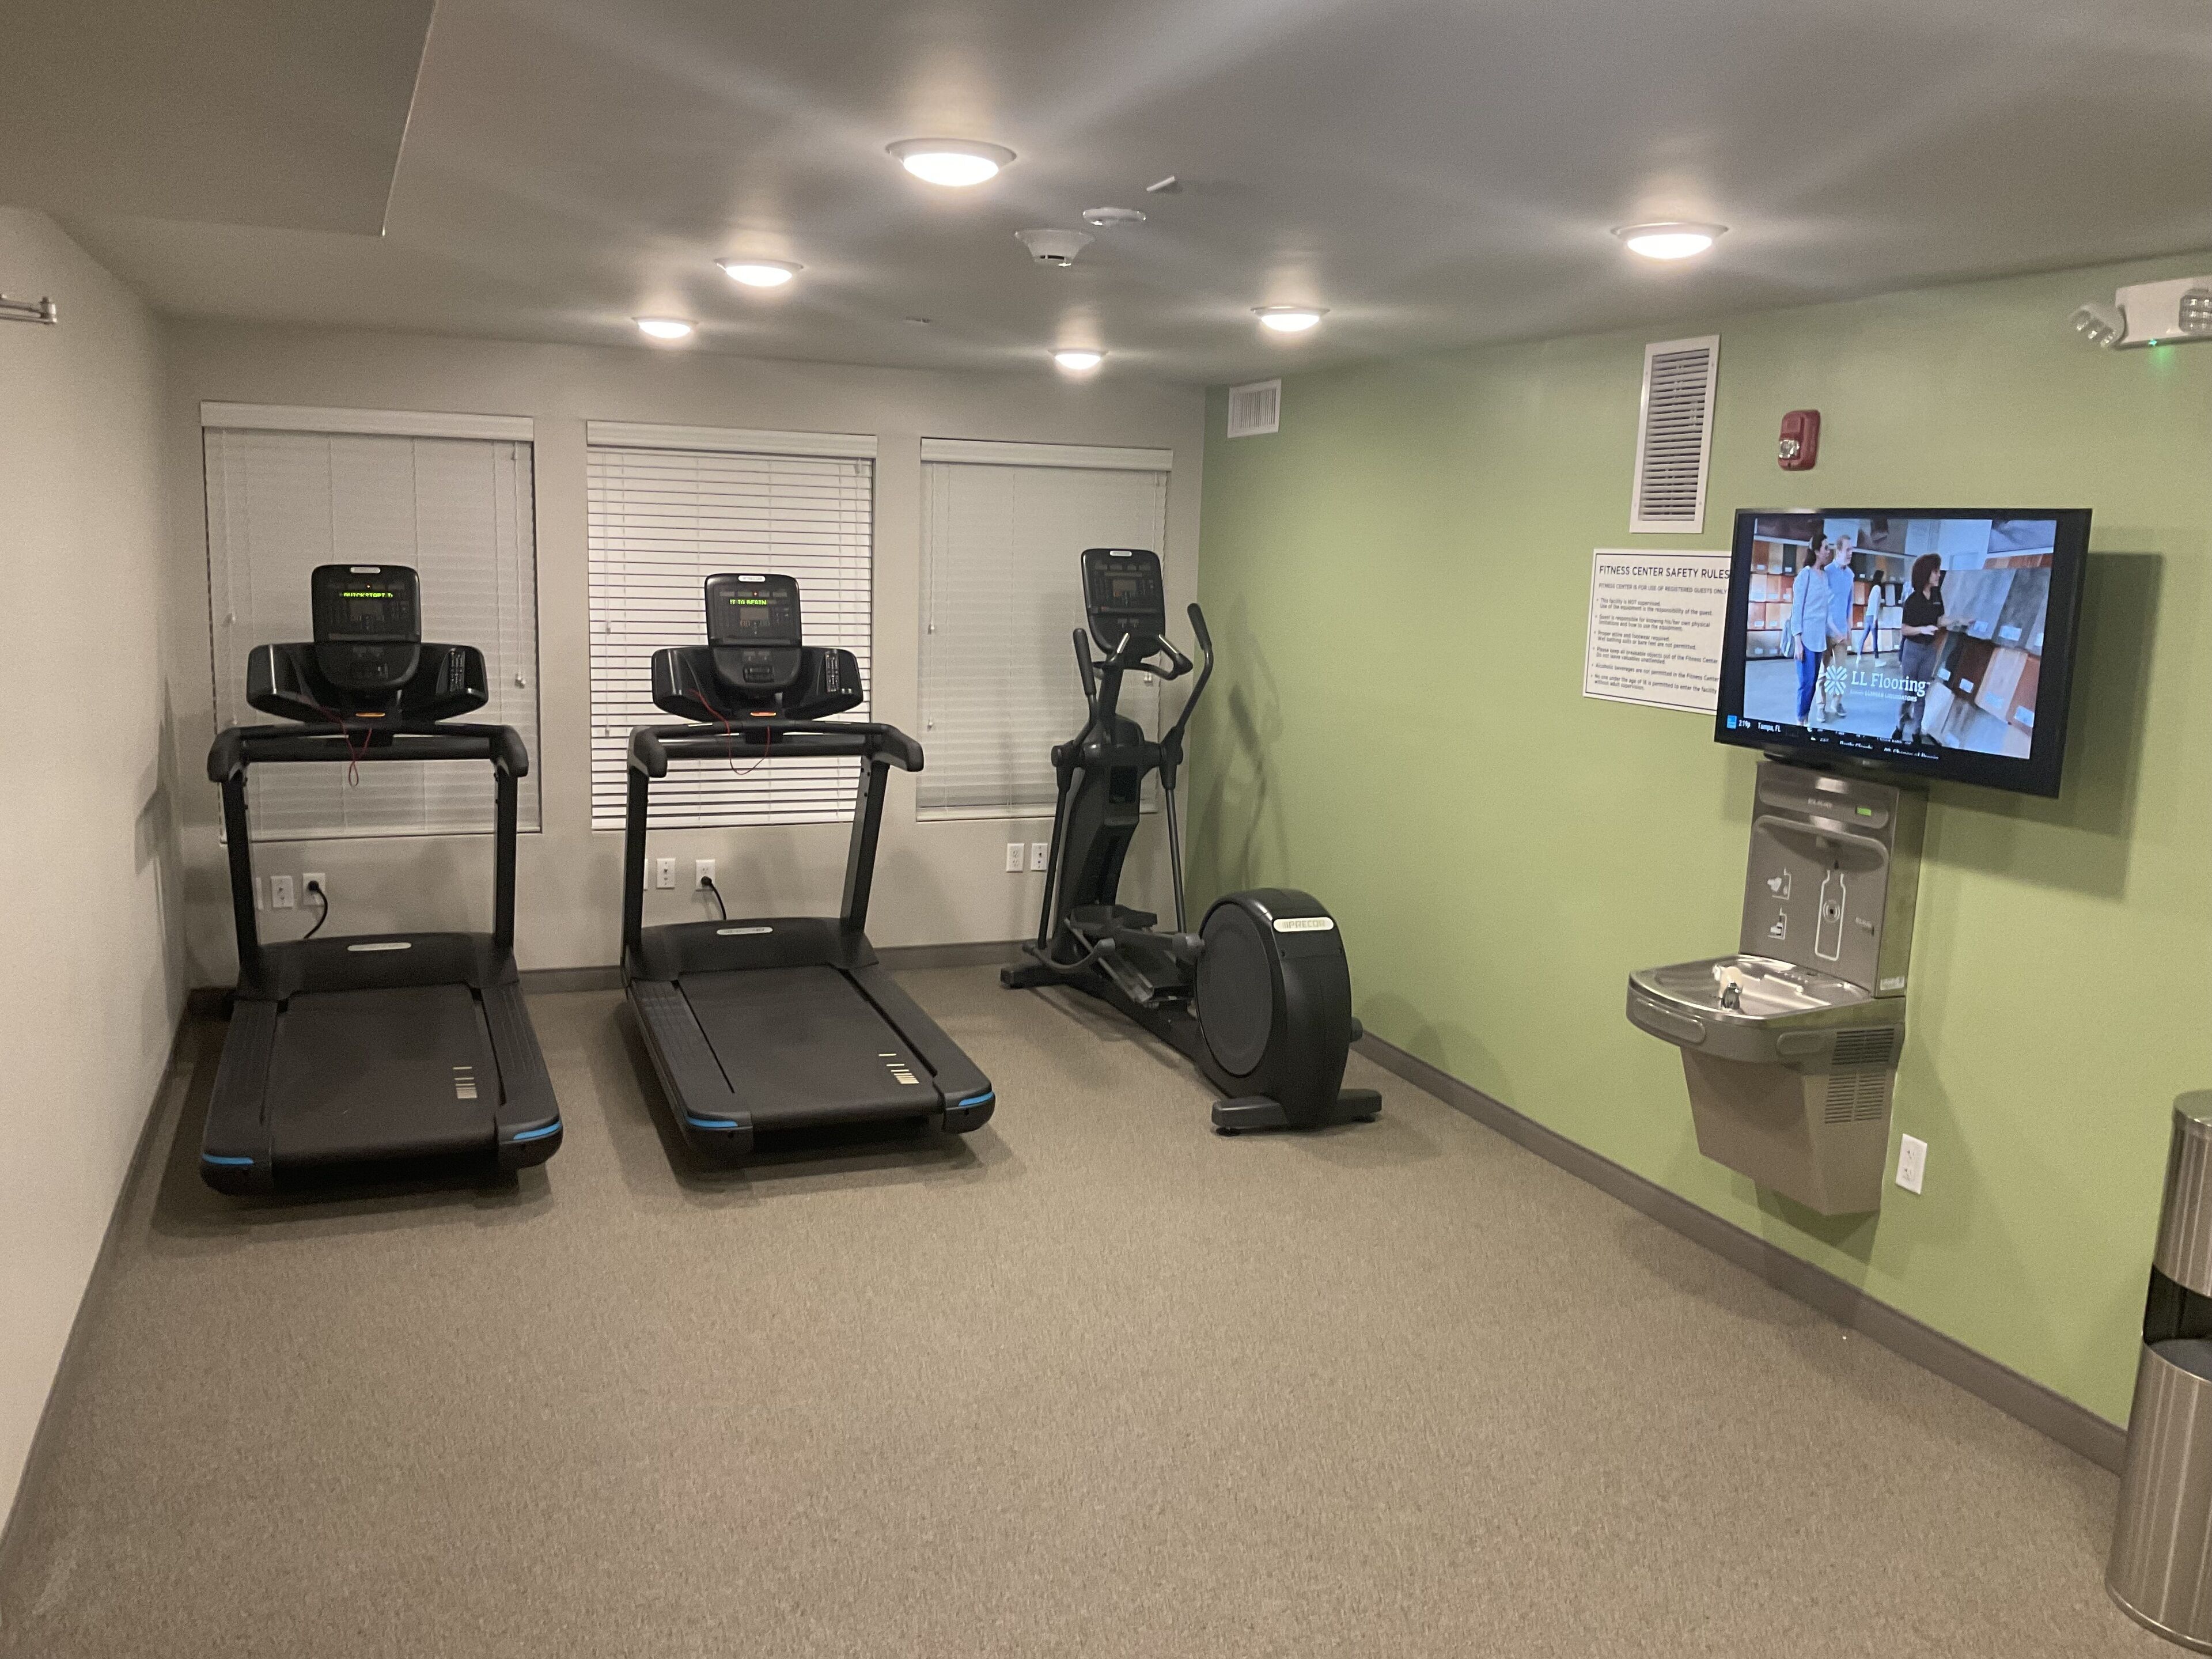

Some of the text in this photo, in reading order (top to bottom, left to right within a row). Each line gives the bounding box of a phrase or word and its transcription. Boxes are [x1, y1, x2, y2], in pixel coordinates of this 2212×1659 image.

[1599, 566, 1730, 579] FITNESS CENTER SAFETY RULES
[1851, 671, 1926, 696] LL Flooring
[1289, 920, 1325, 929] PRECOR
